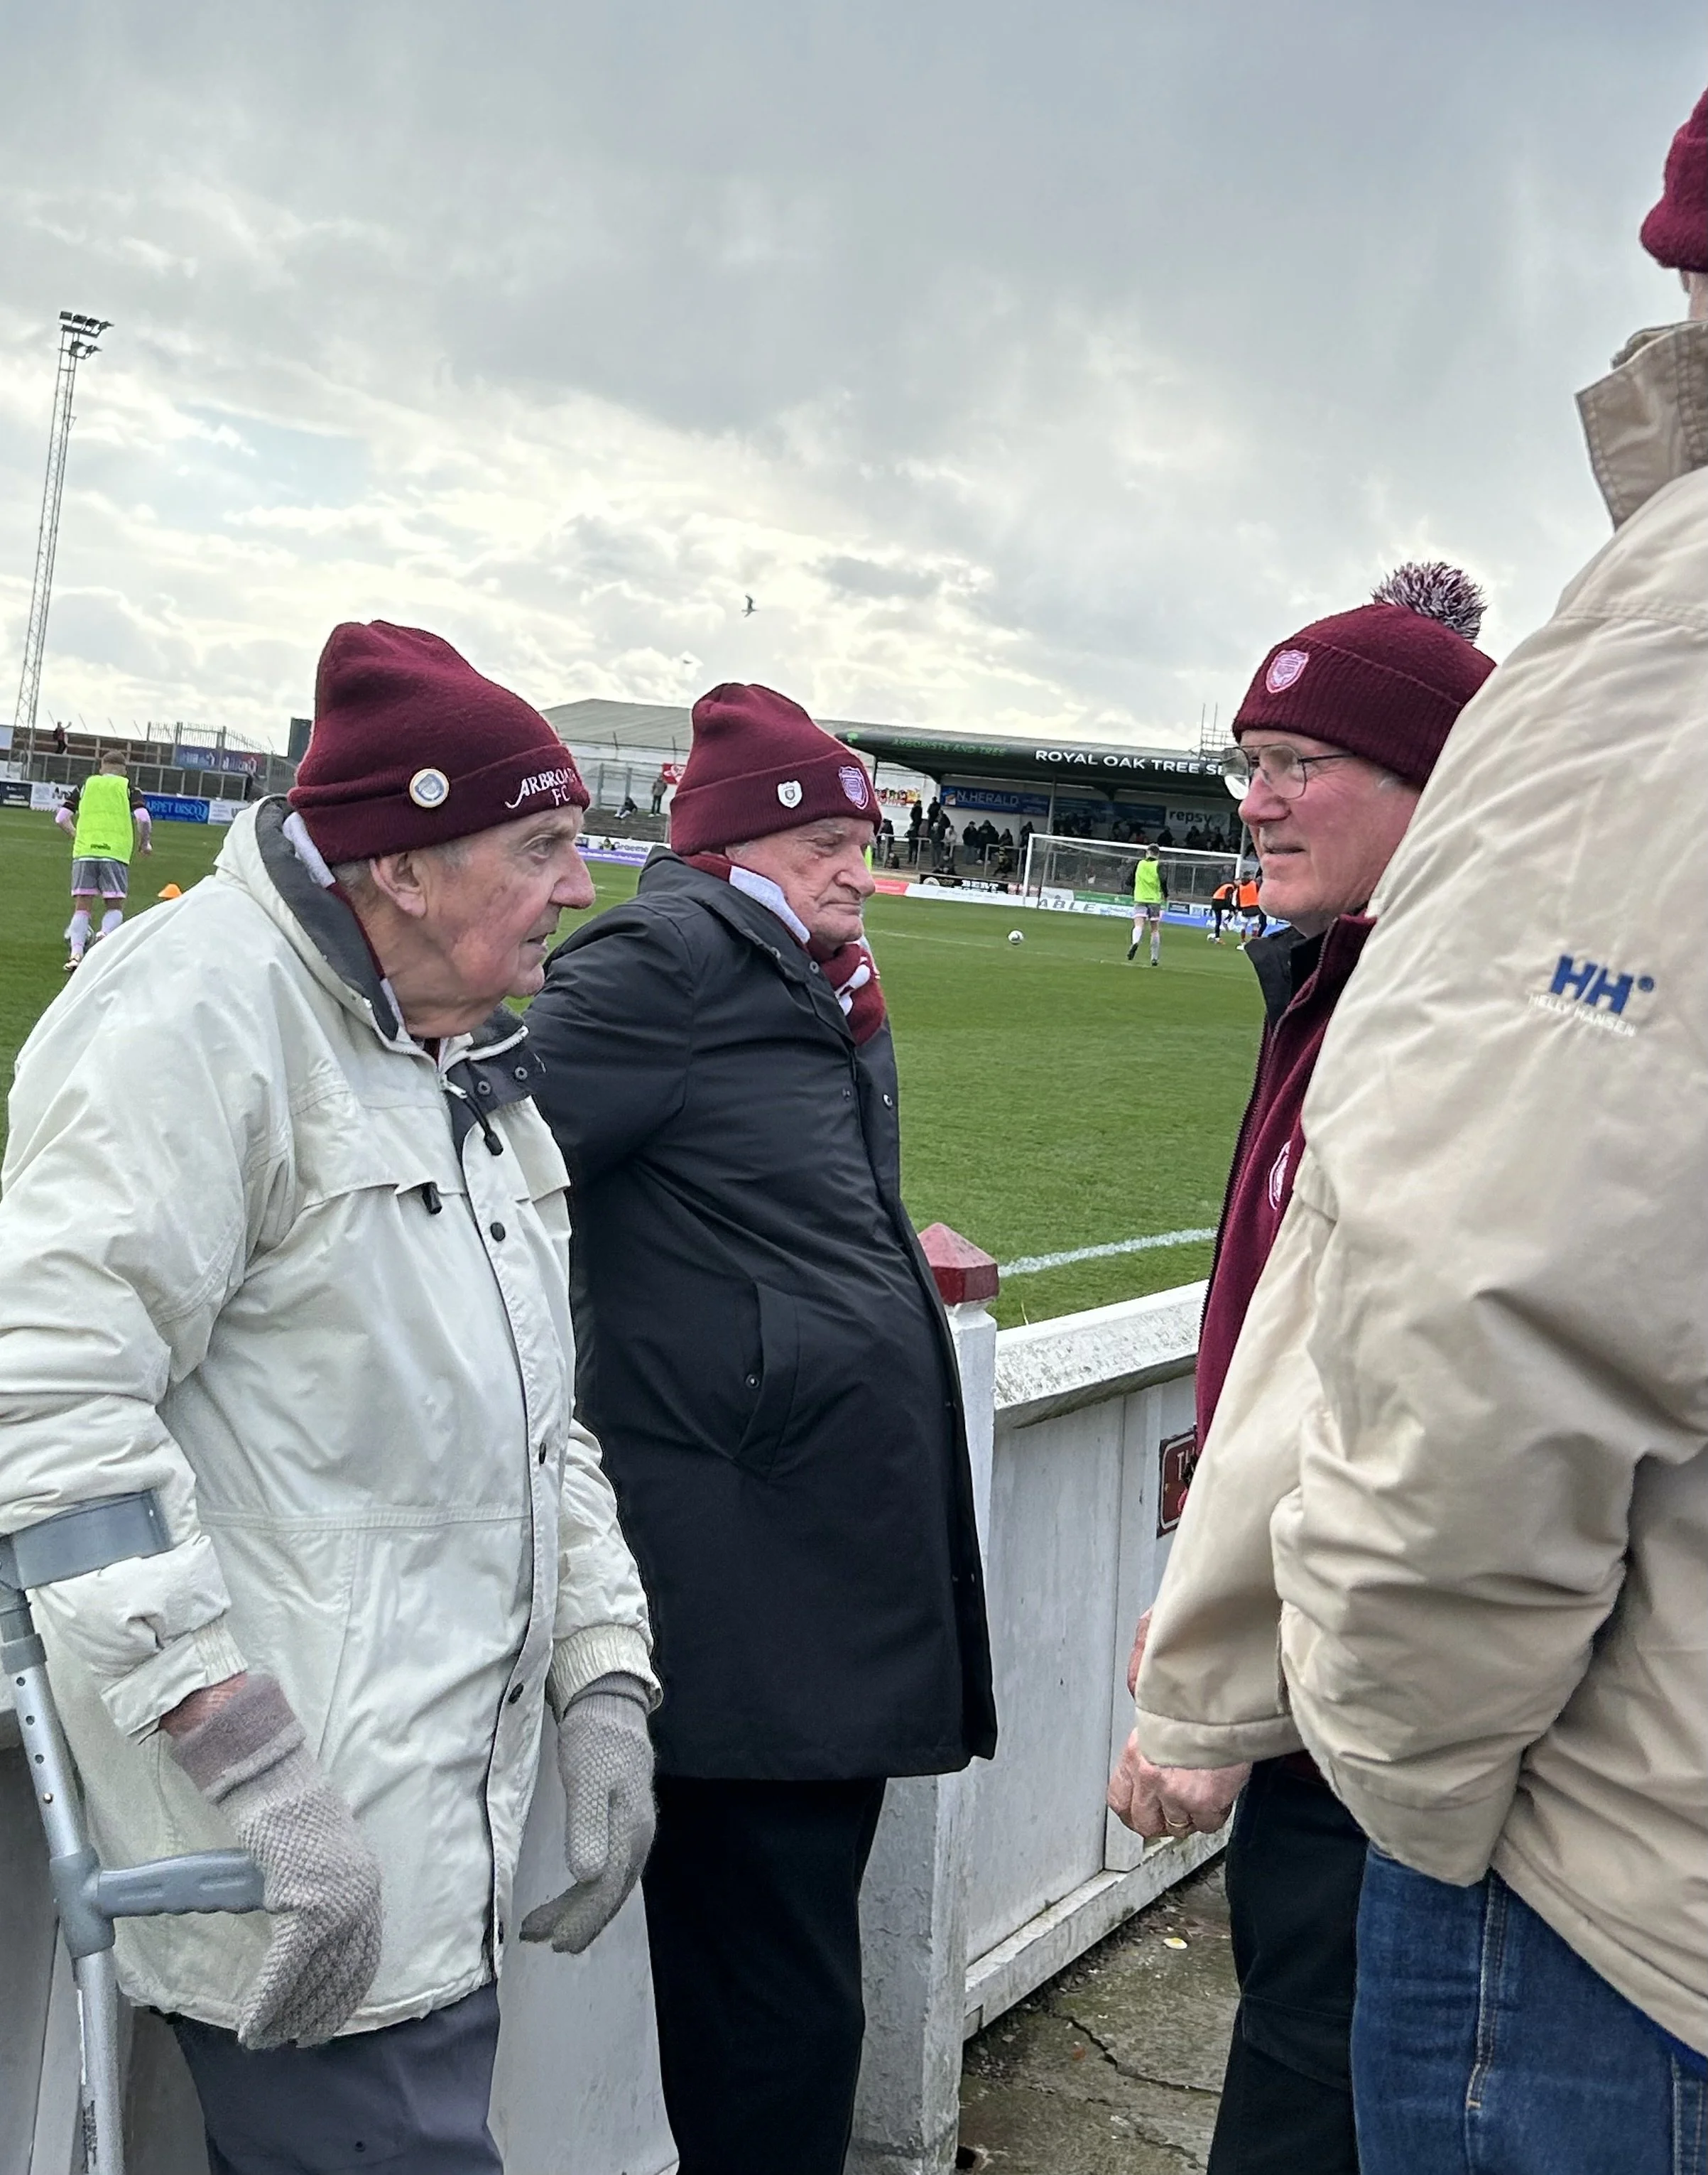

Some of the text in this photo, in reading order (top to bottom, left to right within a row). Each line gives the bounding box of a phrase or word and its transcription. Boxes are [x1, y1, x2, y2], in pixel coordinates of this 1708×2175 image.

[1035, 749, 1098, 766] ROYAL
[1104, 755, 1146, 769] OAK
[1152, 759, 1200, 774] TREE
[552, 784, 570, 806] FC
[1573, 1005, 1636, 1038] HANSEN
